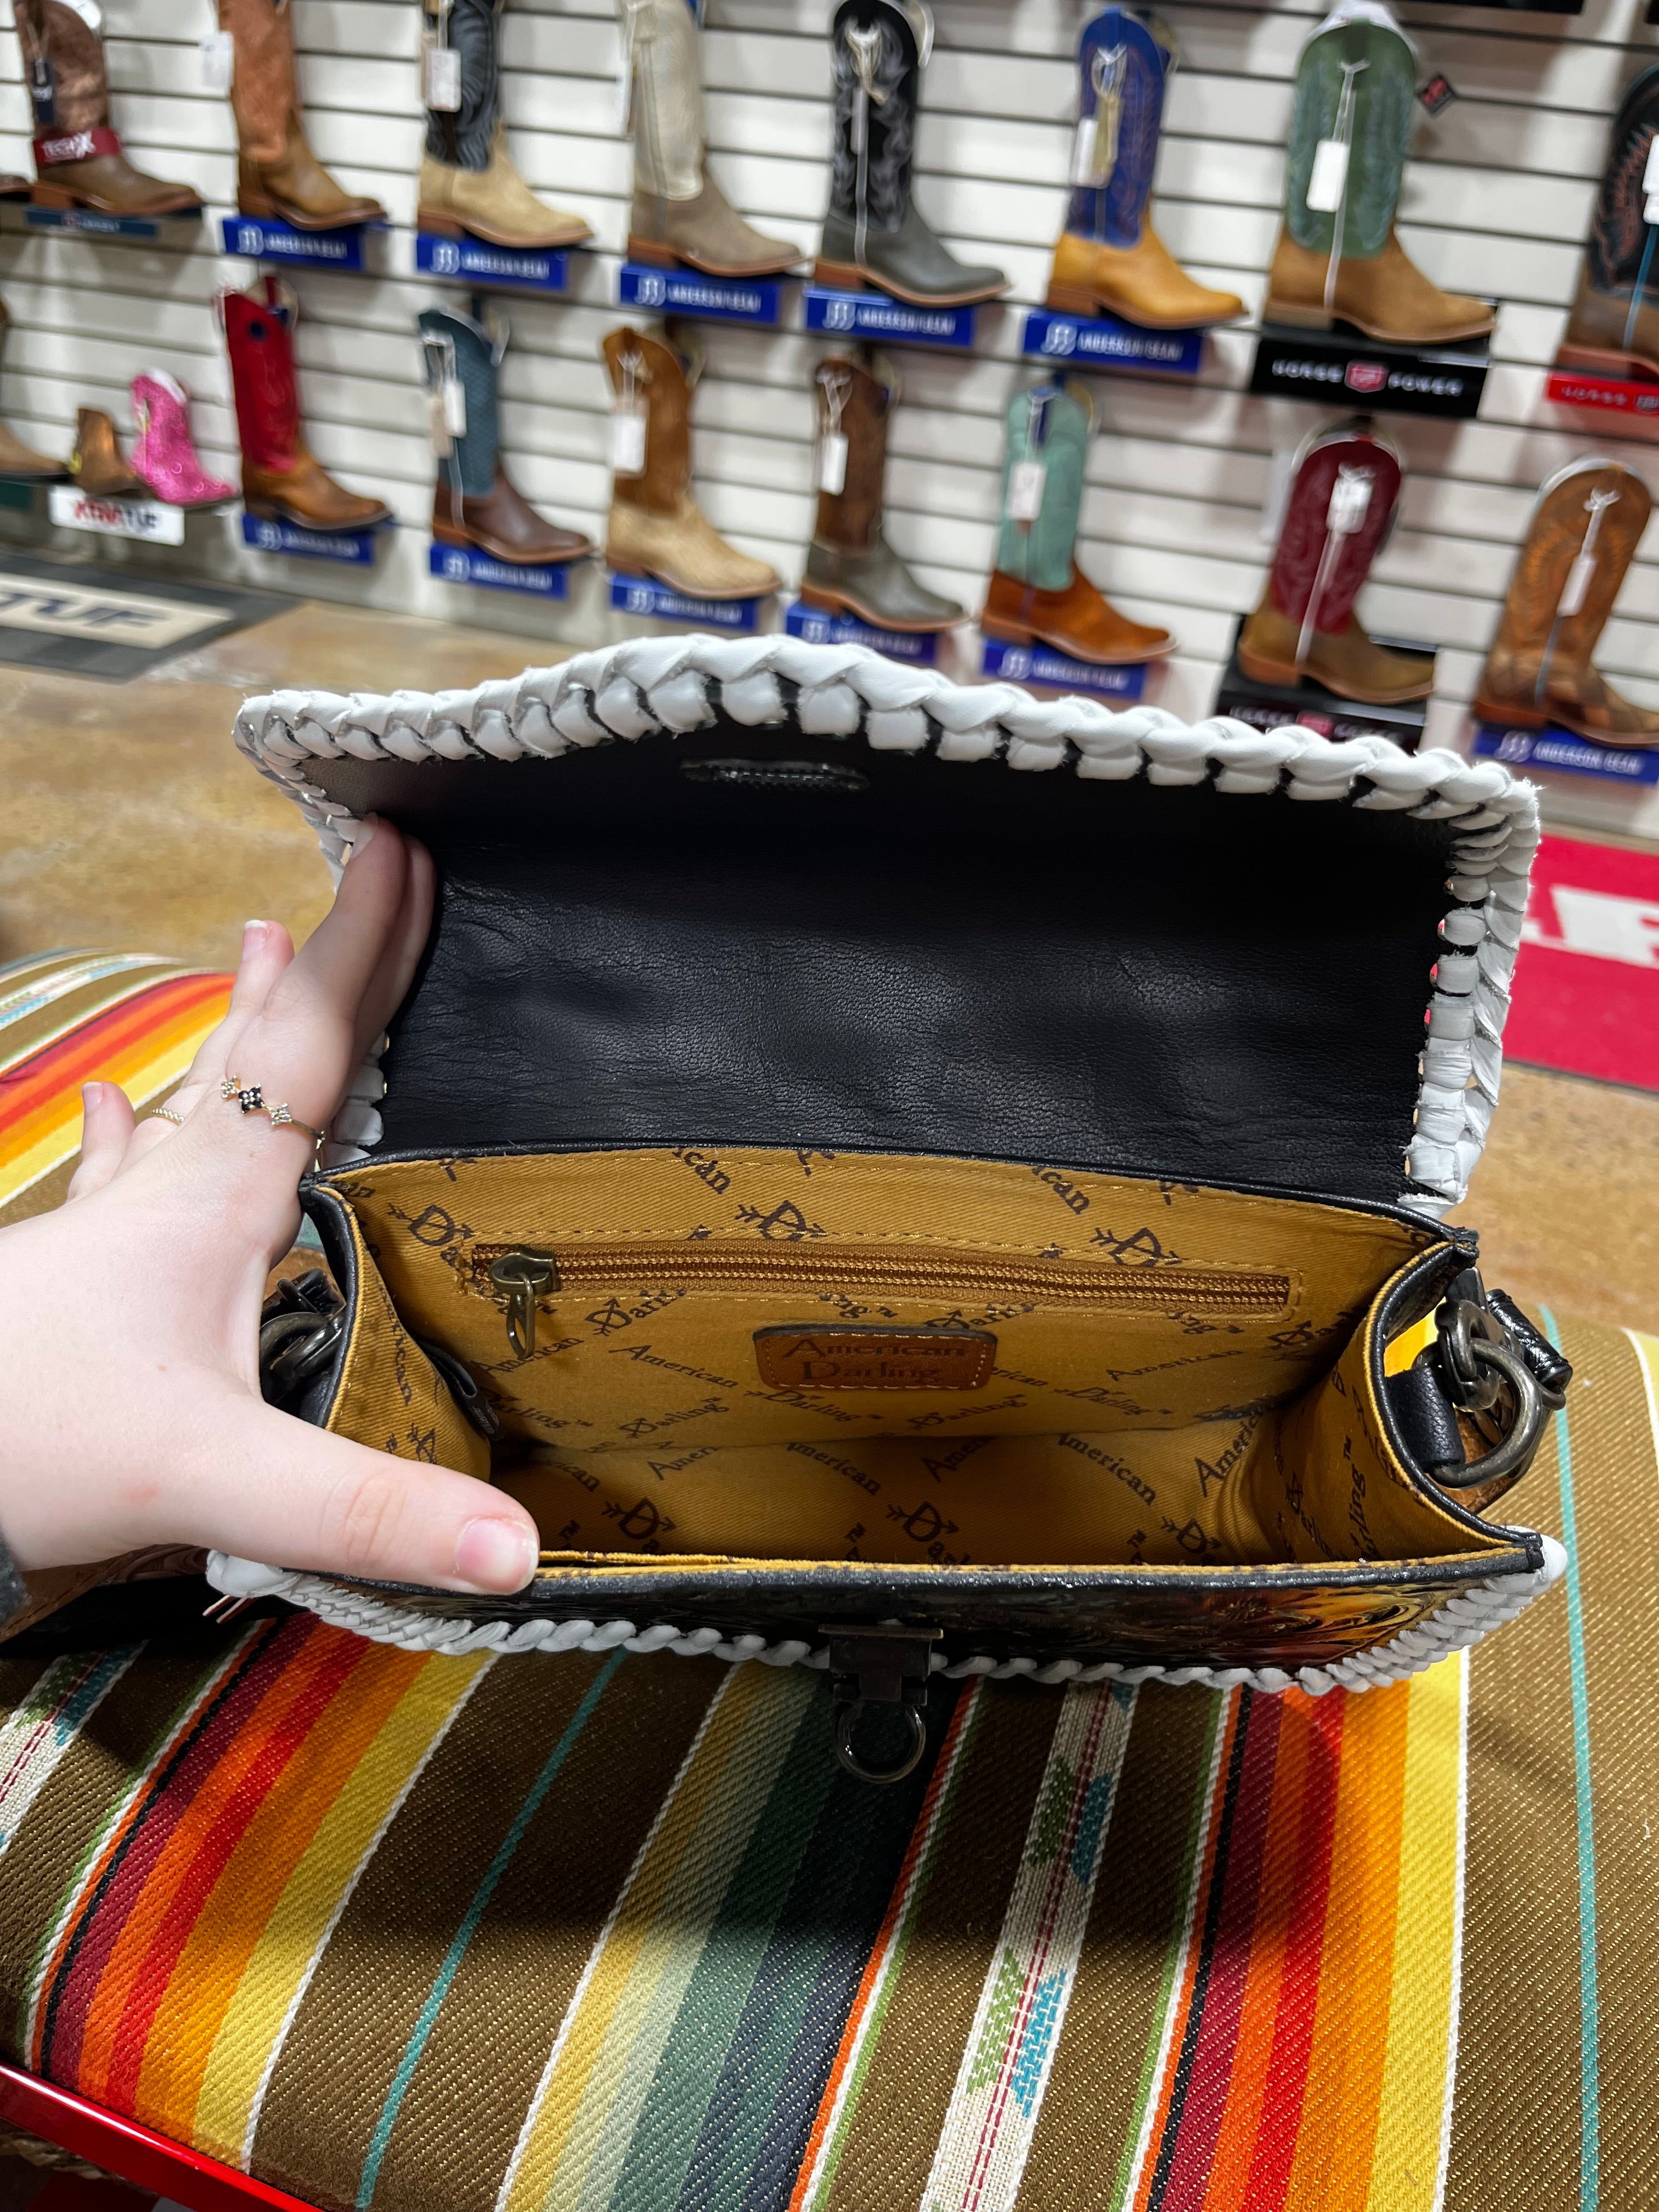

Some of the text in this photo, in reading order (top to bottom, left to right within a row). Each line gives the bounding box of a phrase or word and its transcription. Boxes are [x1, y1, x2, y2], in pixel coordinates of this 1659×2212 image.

[782, 1339, 966, 1358] American
[608, 1345, 738, 1388] American
[803, 1361, 941, 1386] Darling
[1105, 1350, 1243, 1381] American
[618, 1403, 730, 1434] Darling
[765, 1390, 862, 1422] Darling
